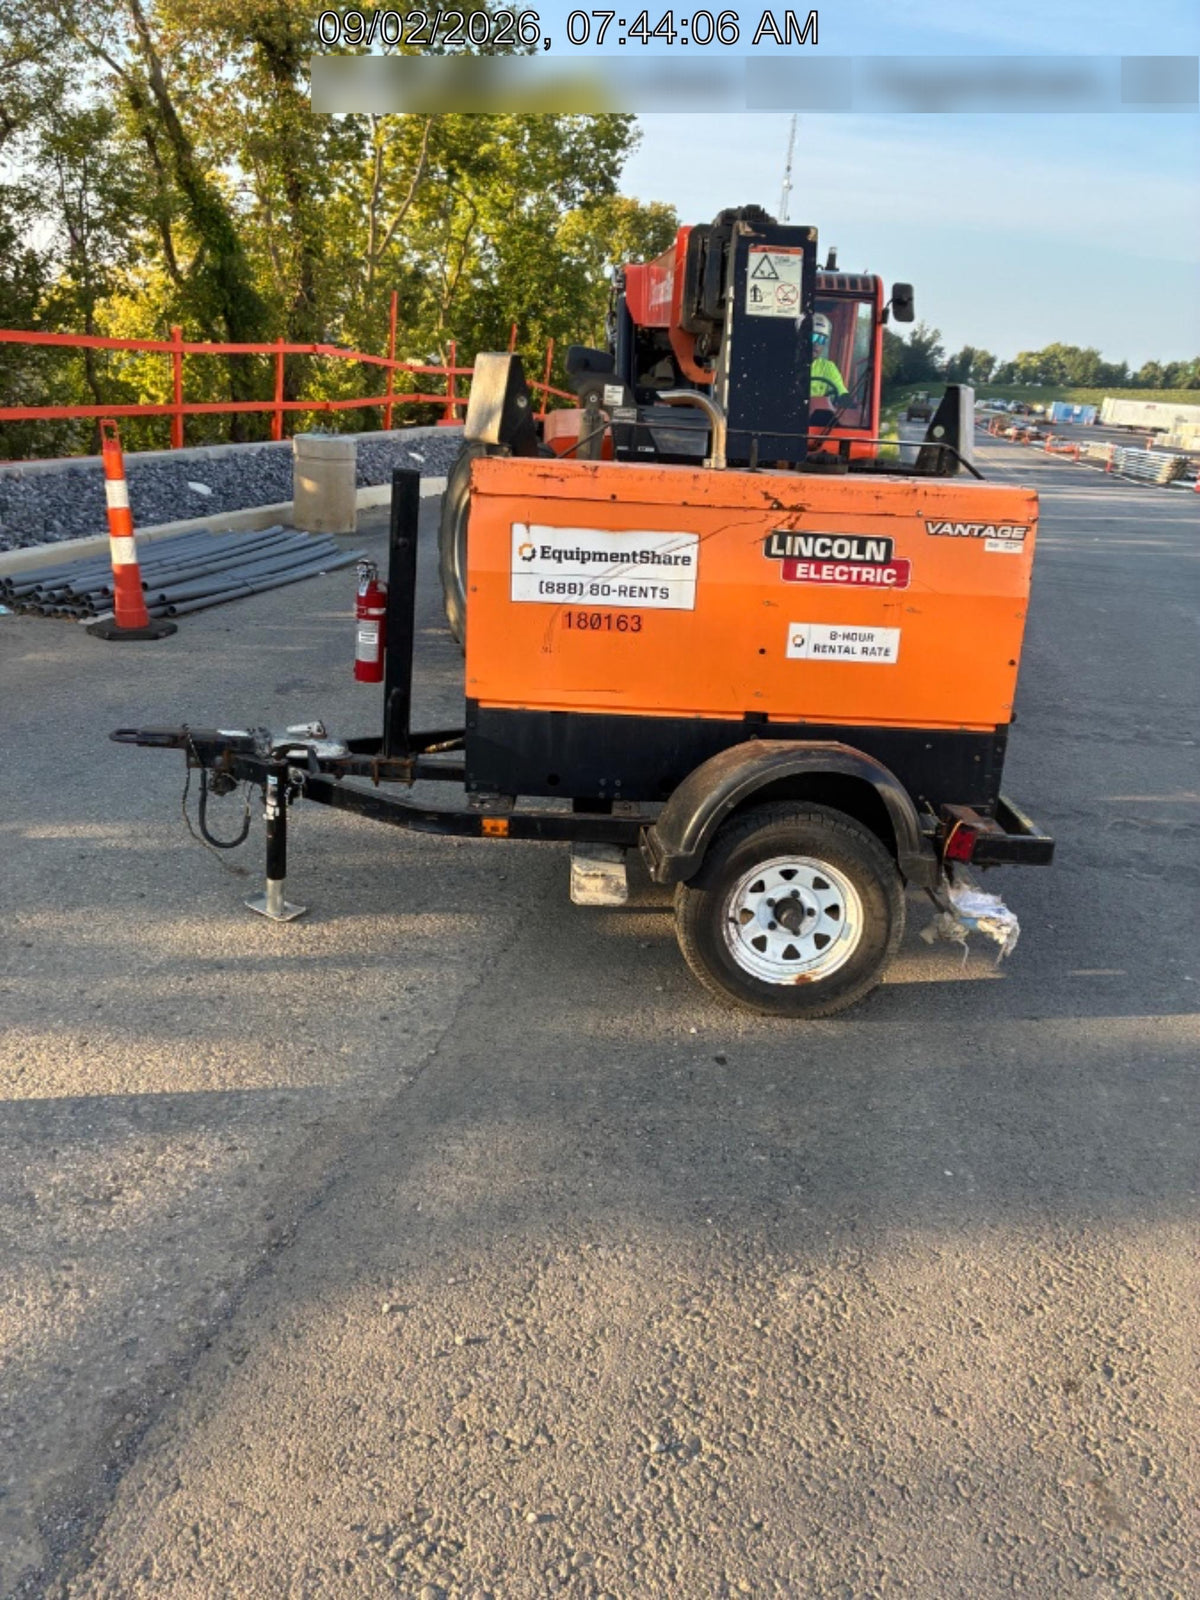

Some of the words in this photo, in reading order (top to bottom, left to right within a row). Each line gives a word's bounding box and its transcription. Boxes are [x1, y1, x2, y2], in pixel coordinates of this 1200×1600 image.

[925, 521, 1027, 540] VANTAGE
[540, 545, 692, 567] EquipmentShare
[770, 534, 886, 562] LINCOLN
[795, 564, 897, 585] ELECTRIC
[539, 580, 584, 596] (888)
[589, 583, 670, 600] 80-RENTS
[564, 611, 642, 632] 180163
[829, 631, 875, 643] 8-HOUR
[813, 643, 857, 655] RENTAL
[861, 646, 891, 657] RATE
